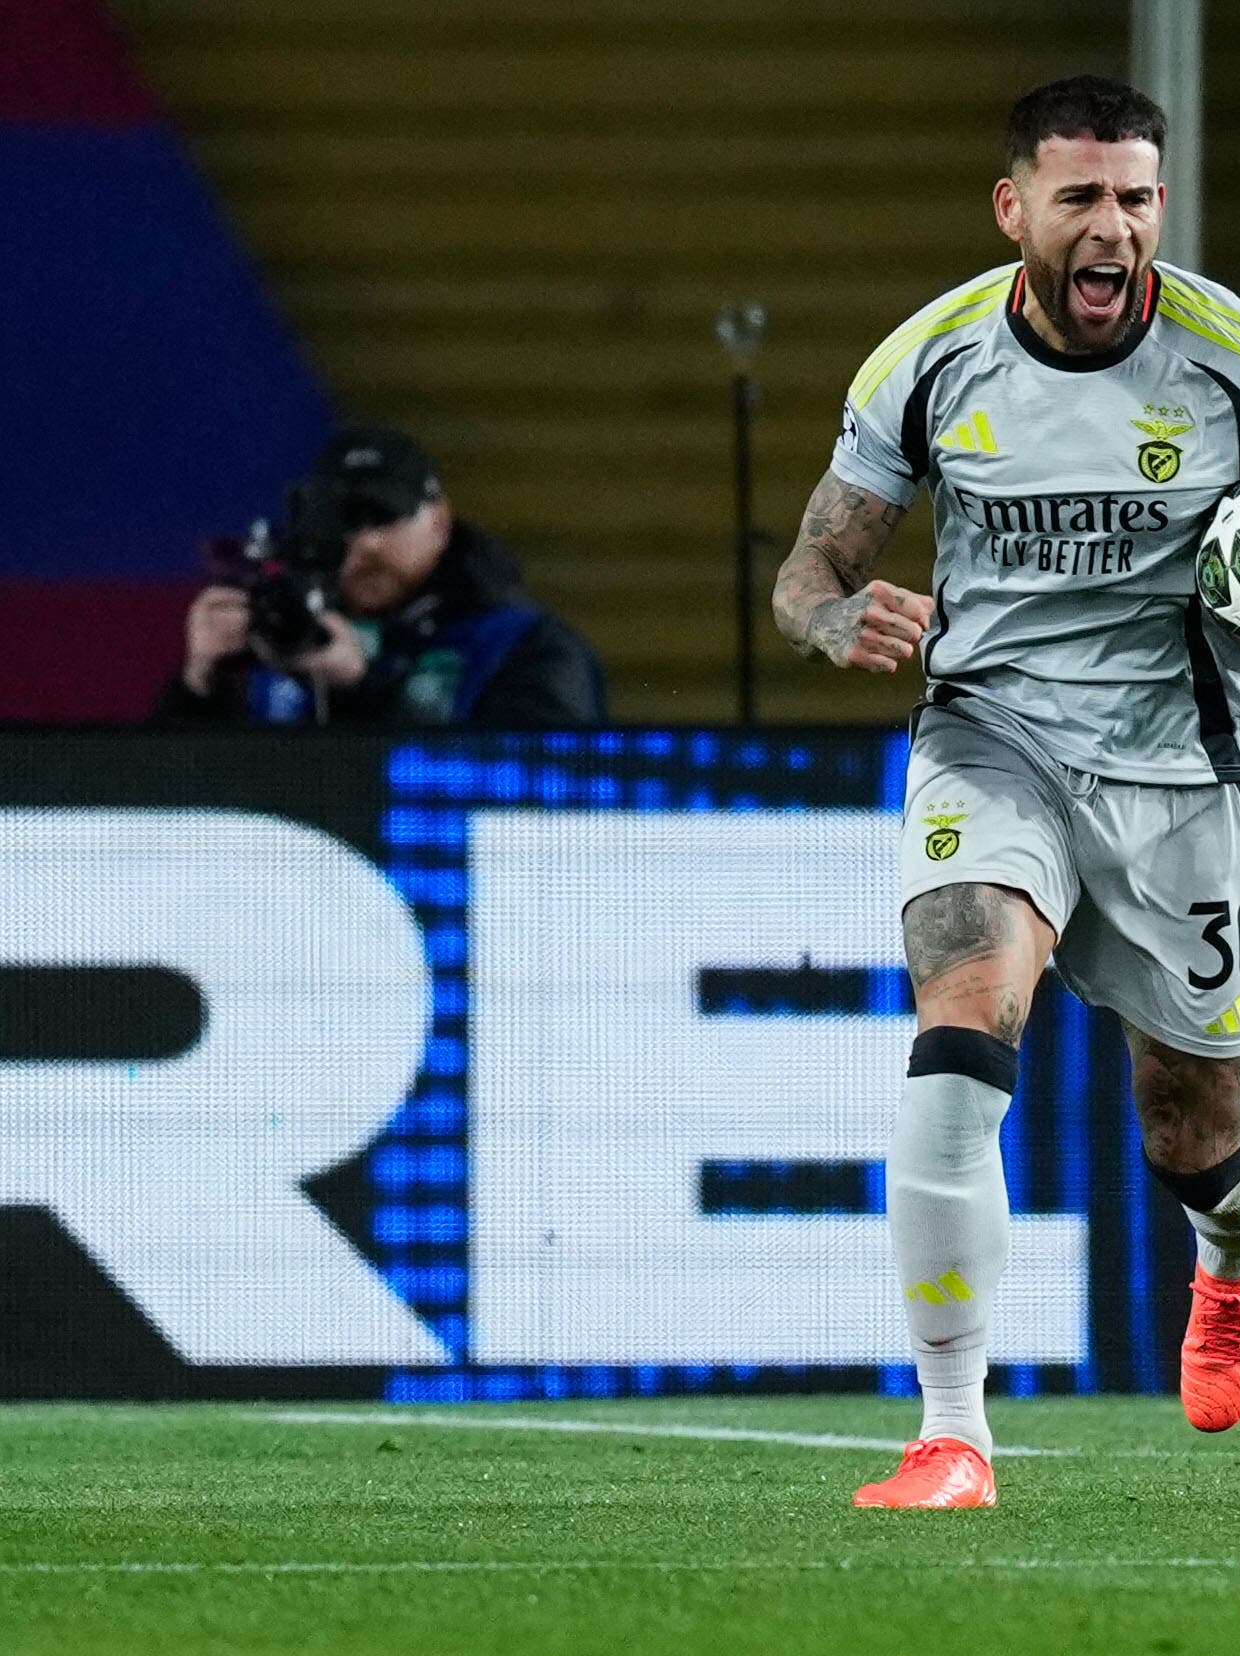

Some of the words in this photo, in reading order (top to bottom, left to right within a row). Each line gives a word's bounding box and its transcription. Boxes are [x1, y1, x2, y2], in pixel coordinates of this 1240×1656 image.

[953, 486, 1169, 533] Emirates
[991, 534, 1028, 567] FLY
[1038, 538, 1134, 576] BETTER
